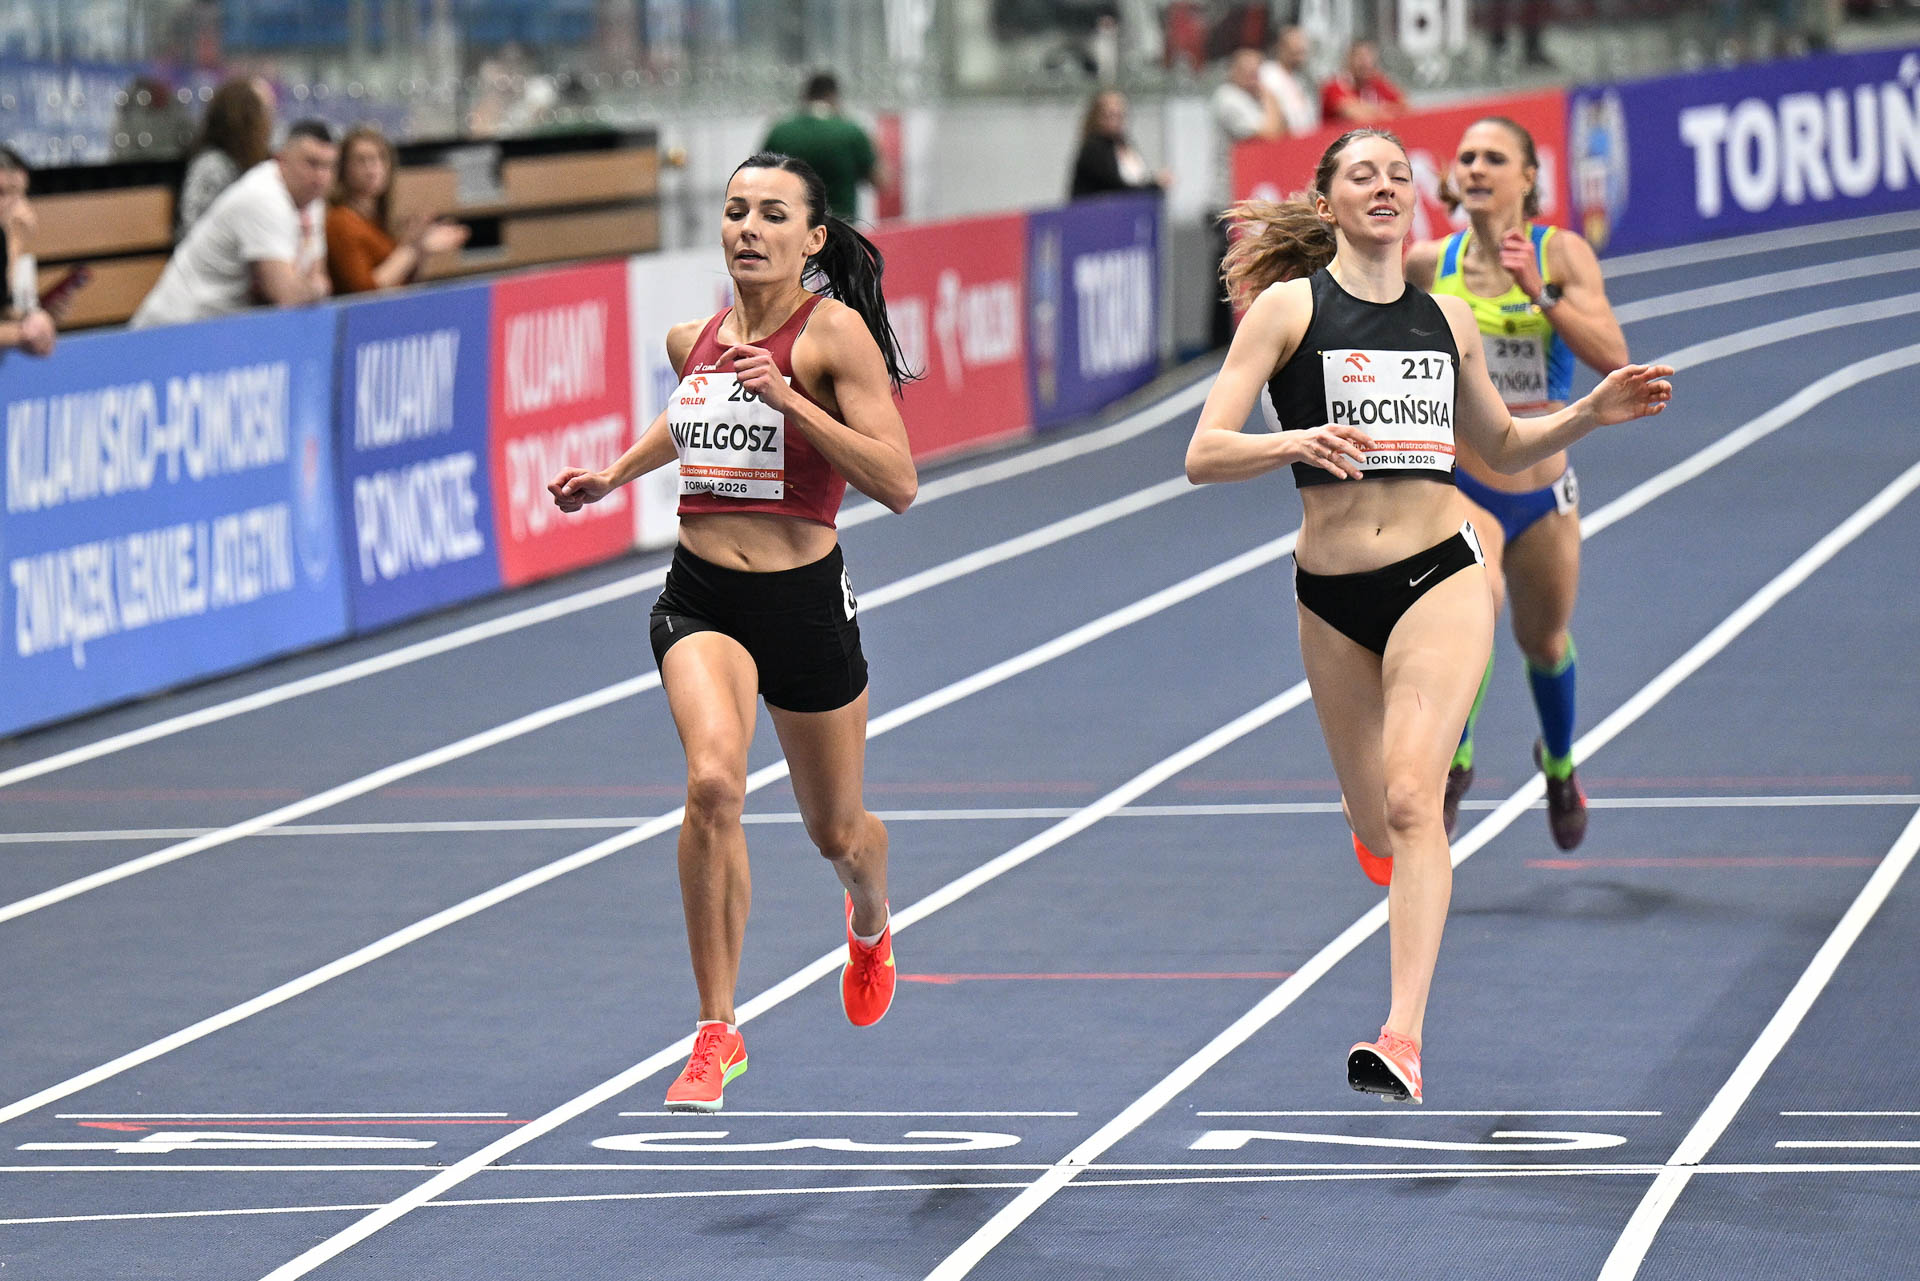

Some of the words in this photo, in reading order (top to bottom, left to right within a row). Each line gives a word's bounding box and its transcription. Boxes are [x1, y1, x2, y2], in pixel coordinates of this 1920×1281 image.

[1679, 52, 1920, 218] TORUŃ
[1401, 357, 1444, 380] 217
[1342, 375, 1376, 383] ORLEN
[680, 397, 706, 406] ORLEN
[1331, 394, 1451, 428] PŁOCIŃSKA
[670, 422, 777, 453] WIELGOSZ
[1408, 455, 1436, 465] 2026
[687, 467, 708, 475] Halowe
[708, 468, 752, 478] Mistrzostwa
[754, 470, 778, 479] Polski
[684, 480, 715, 491] TORUŃ
[717, 482, 747, 493] 2026
